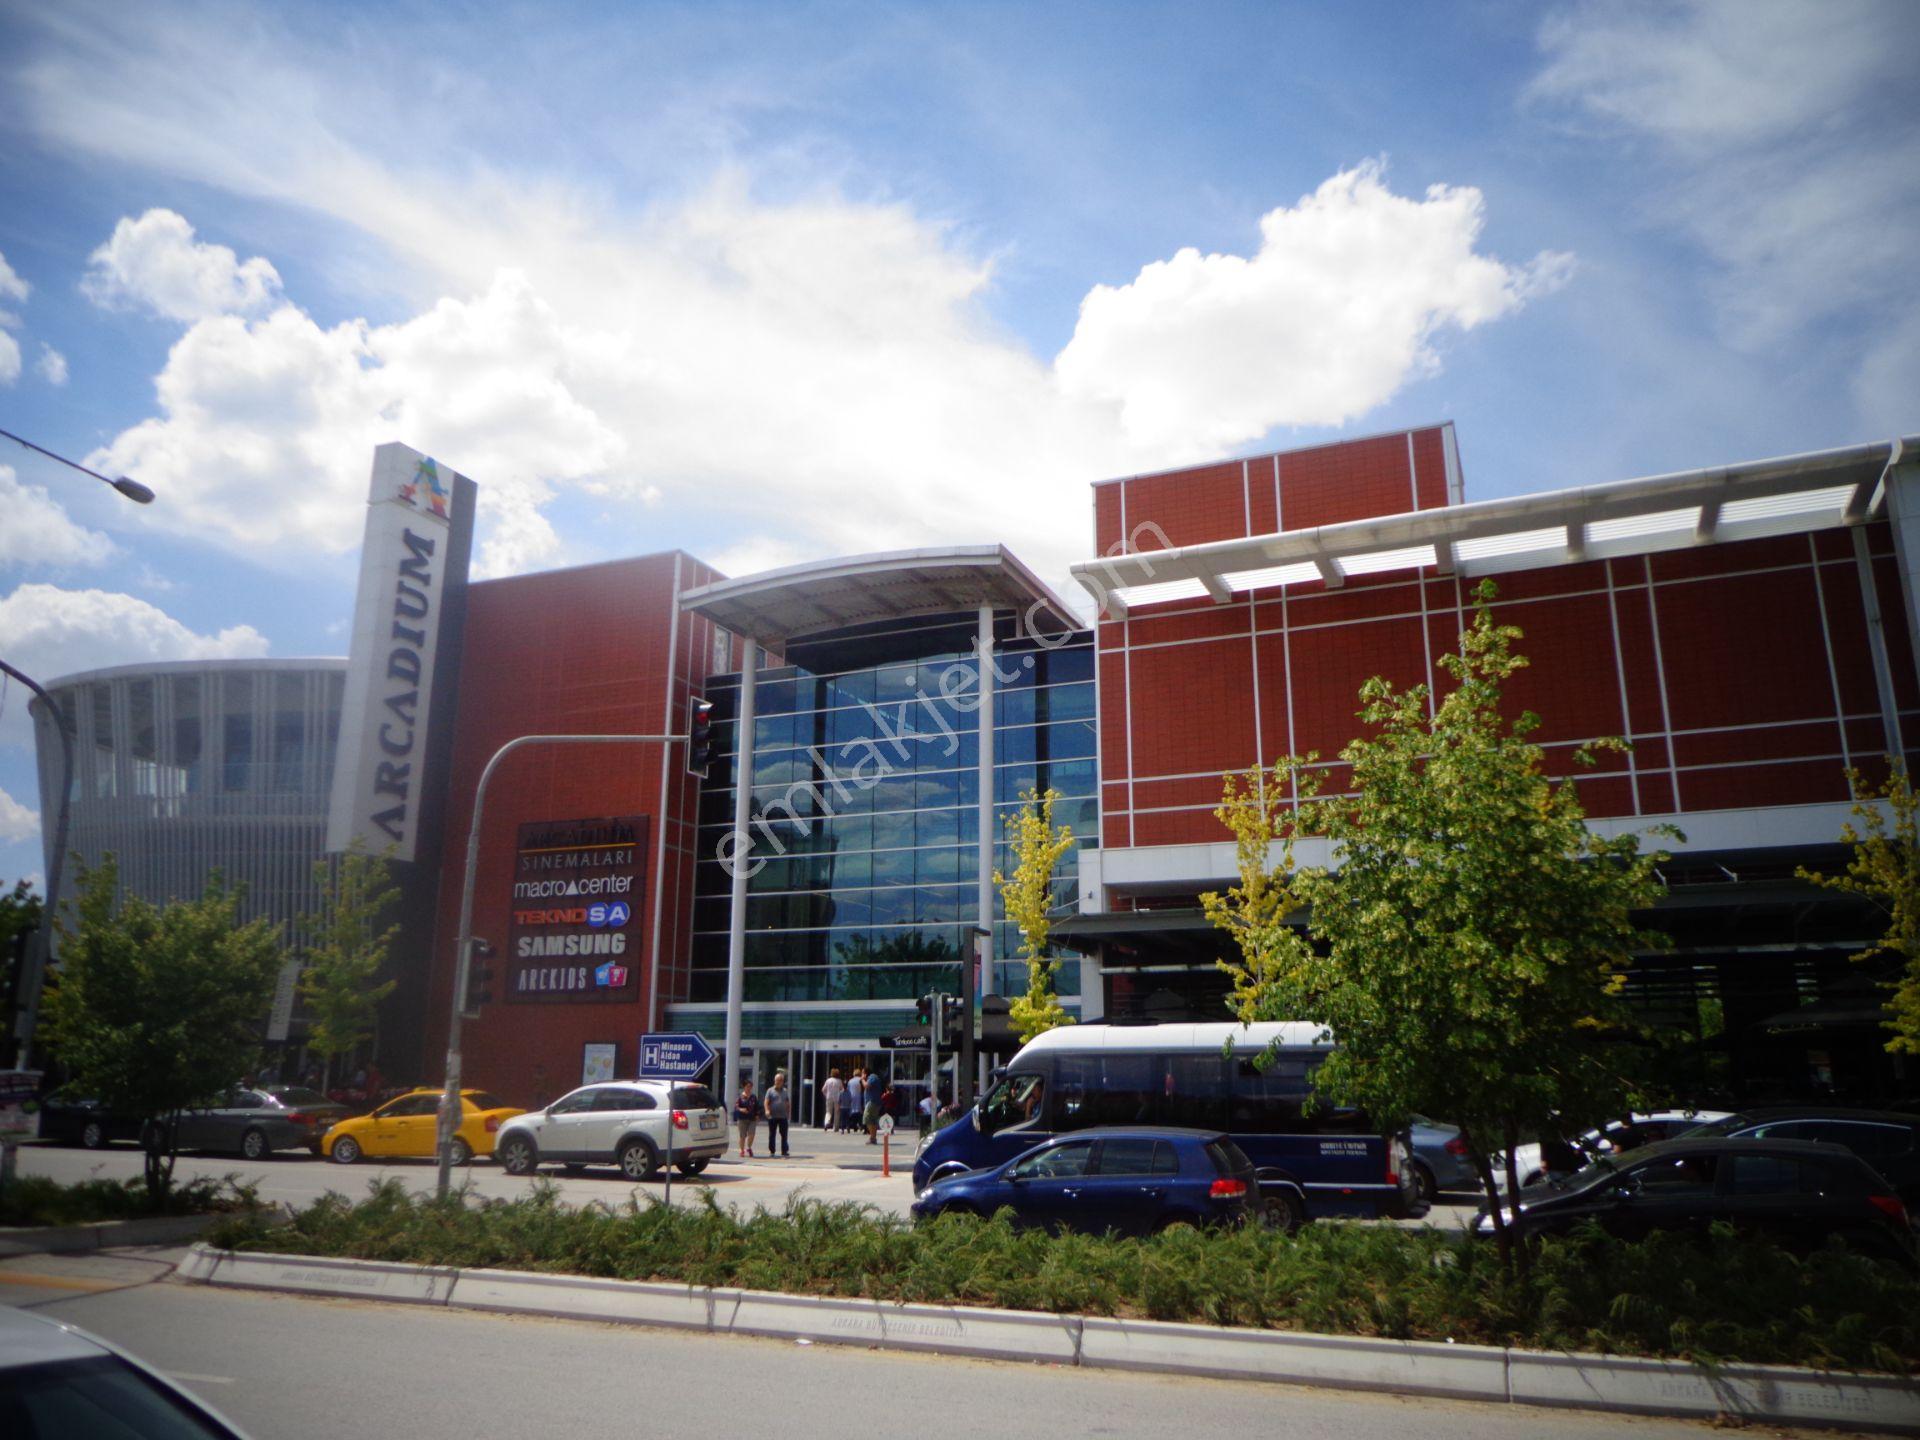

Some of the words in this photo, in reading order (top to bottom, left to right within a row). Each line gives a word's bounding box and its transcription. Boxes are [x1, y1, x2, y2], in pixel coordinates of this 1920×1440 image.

[371, 528, 435, 841] ARCADIUM
[518, 933, 626, 957] SAMSUNG
[518, 967, 586, 991] ARCKIDS
[661, 1042, 692, 1051] Minasera
[660, 1051, 680, 1060] Aldan
[660, 1060, 698, 1071] Hastanesi
